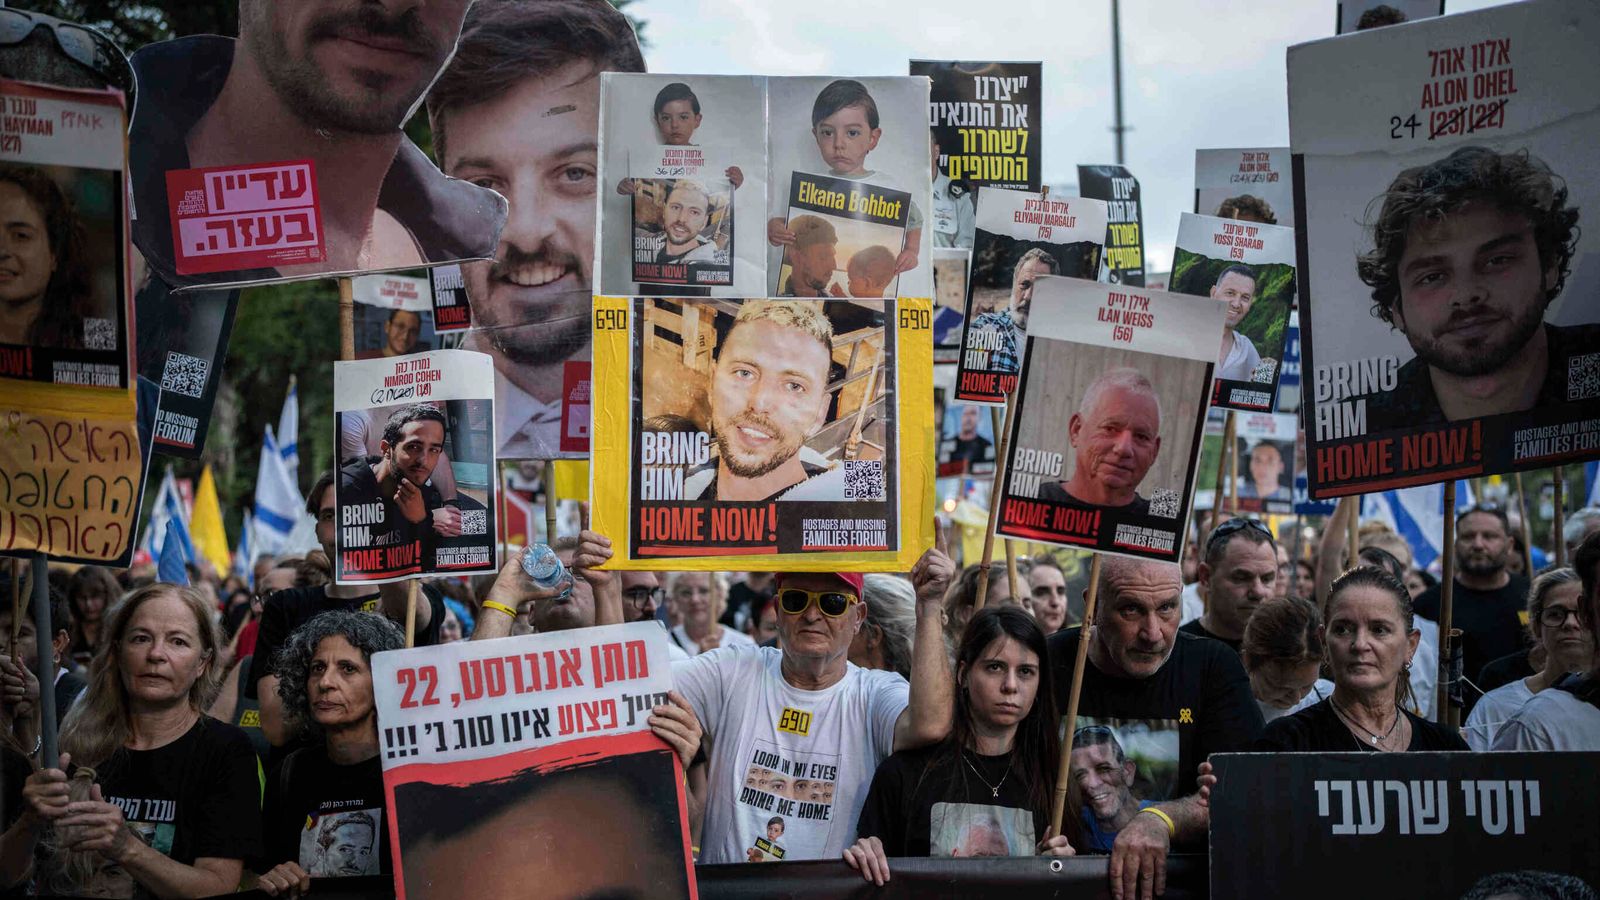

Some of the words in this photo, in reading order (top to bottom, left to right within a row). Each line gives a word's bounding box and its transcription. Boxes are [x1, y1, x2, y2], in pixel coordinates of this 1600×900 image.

[1428, 46, 1465, 78] אהל
[1472, 38, 1511, 73] אלון
[1421, 79, 1468, 109] ALON
[1474, 68, 1518, 99] OHEL
[4, 116, 53, 136] HAYMAN
[1001, 103, 1028, 128] את
[1390, 114, 1422, 140] 24
[958, 127, 1028, 155] לשחרור
[213, 169, 307, 211] עדיין
[799, 181, 845, 210] Elkana
[848, 190, 902, 220] Bohbot
[1014, 211, 1042, 225] ELIYAHU
[1043, 215, 1076, 228] MARGALIT
[196, 213, 314, 251] בעזה.
[635, 237, 661, 250] BRING
[1038, 226, 1052, 239] (75)
[1214, 234, 1233, 246] YOSSI
[1234, 236, 1264, 250] SHARABI
[635, 249, 652, 263] HIM
[1230, 247, 1244, 260] (53)
[434, 273, 464, 291] BRING
[635, 263, 660, 277] HOME
[662, 261, 688, 279] NOW!
[435, 289, 456, 307] HIM
[1128, 295, 1150, 312] אילן
[437, 306, 466, 323] HOME
[596, 309, 627, 330] 690
[900, 308, 930, 330] 690
[1097, 307, 1120, 323] ILAN
[1122, 311, 1154, 328] WEISS
[967, 330, 1004, 350] BRING
[1113, 326, 1133, 342] (56)
[410, 358, 430, 371] נמרוד
[964, 350, 988, 370] HIM
[53, 370, 90, 385] FAMILIES
[91, 373, 120, 388] FORUM
[385, 373, 414, 387] NIMROD
[415, 369, 442, 383] COHEN
[961, 373, 996, 394] HOME
[1315, 355, 1399, 403] BRING
[164, 412, 199, 428] MISSING
[1315, 399, 1367, 442] HIM
[1514, 425, 1560, 442] HOSTAGES
[1560, 422, 1579, 438] AND
[156, 421, 196, 445] FORUM
[641, 431, 711, 466] BRING
[1317, 438, 1394, 484] HOME
[1402, 420, 1484, 471] NOW!
[1514, 436, 1570, 460] FAMILIES
[1573, 431, 1600, 451] FOR
[1013, 447, 1063, 478] BRING
[641, 467, 686, 501] HIM
[1008, 472, 1041, 499] HIM
[342, 502, 385, 526] BRING
[640, 508, 705, 542] HOME
[711, 503, 778, 542] NOW!
[803, 519, 840, 531] HOSTAGES
[840, 519, 855, 531] AND
[855, 519, 886, 531] MISSING
[1004, 498, 1051, 528] HOME
[1053, 506, 1101, 536] NOW!
[343, 526, 371, 548] HIM
[803, 531, 849, 547] FAMILIES
[850, 530, 887, 547] FORUM
[1114, 531, 1147, 547] FAMILIES
[1147, 536, 1174, 551] FORUM
[343, 549, 384, 572] HOME
[386, 540, 422, 569] NOW!
[436, 554, 466, 565] FAMILIES
[466, 553, 490, 564] FORUM
[591, 640, 649, 689] מתן
[397, 665, 440, 709] 22
[242, 711, 260, 726] 69
[502, 707, 552, 743] אינו
[558, 699, 619, 736] פצוע
[779, 709, 810, 733] 690
[453, 715, 493, 750] סוג
[752, 749, 779, 770] LOOK
[782, 758, 790, 774] IN
[793, 762, 808, 778] MY
[810, 763, 837, 781] EYES
[144, 799, 176, 821] ענבר
[739, 786, 774, 811] BRING
[776, 798, 796, 817] ME
[798, 802, 831, 821] HOME
[1314, 780, 1450, 835] שרעבי
[1461, 780, 1541, 835] יוסי
